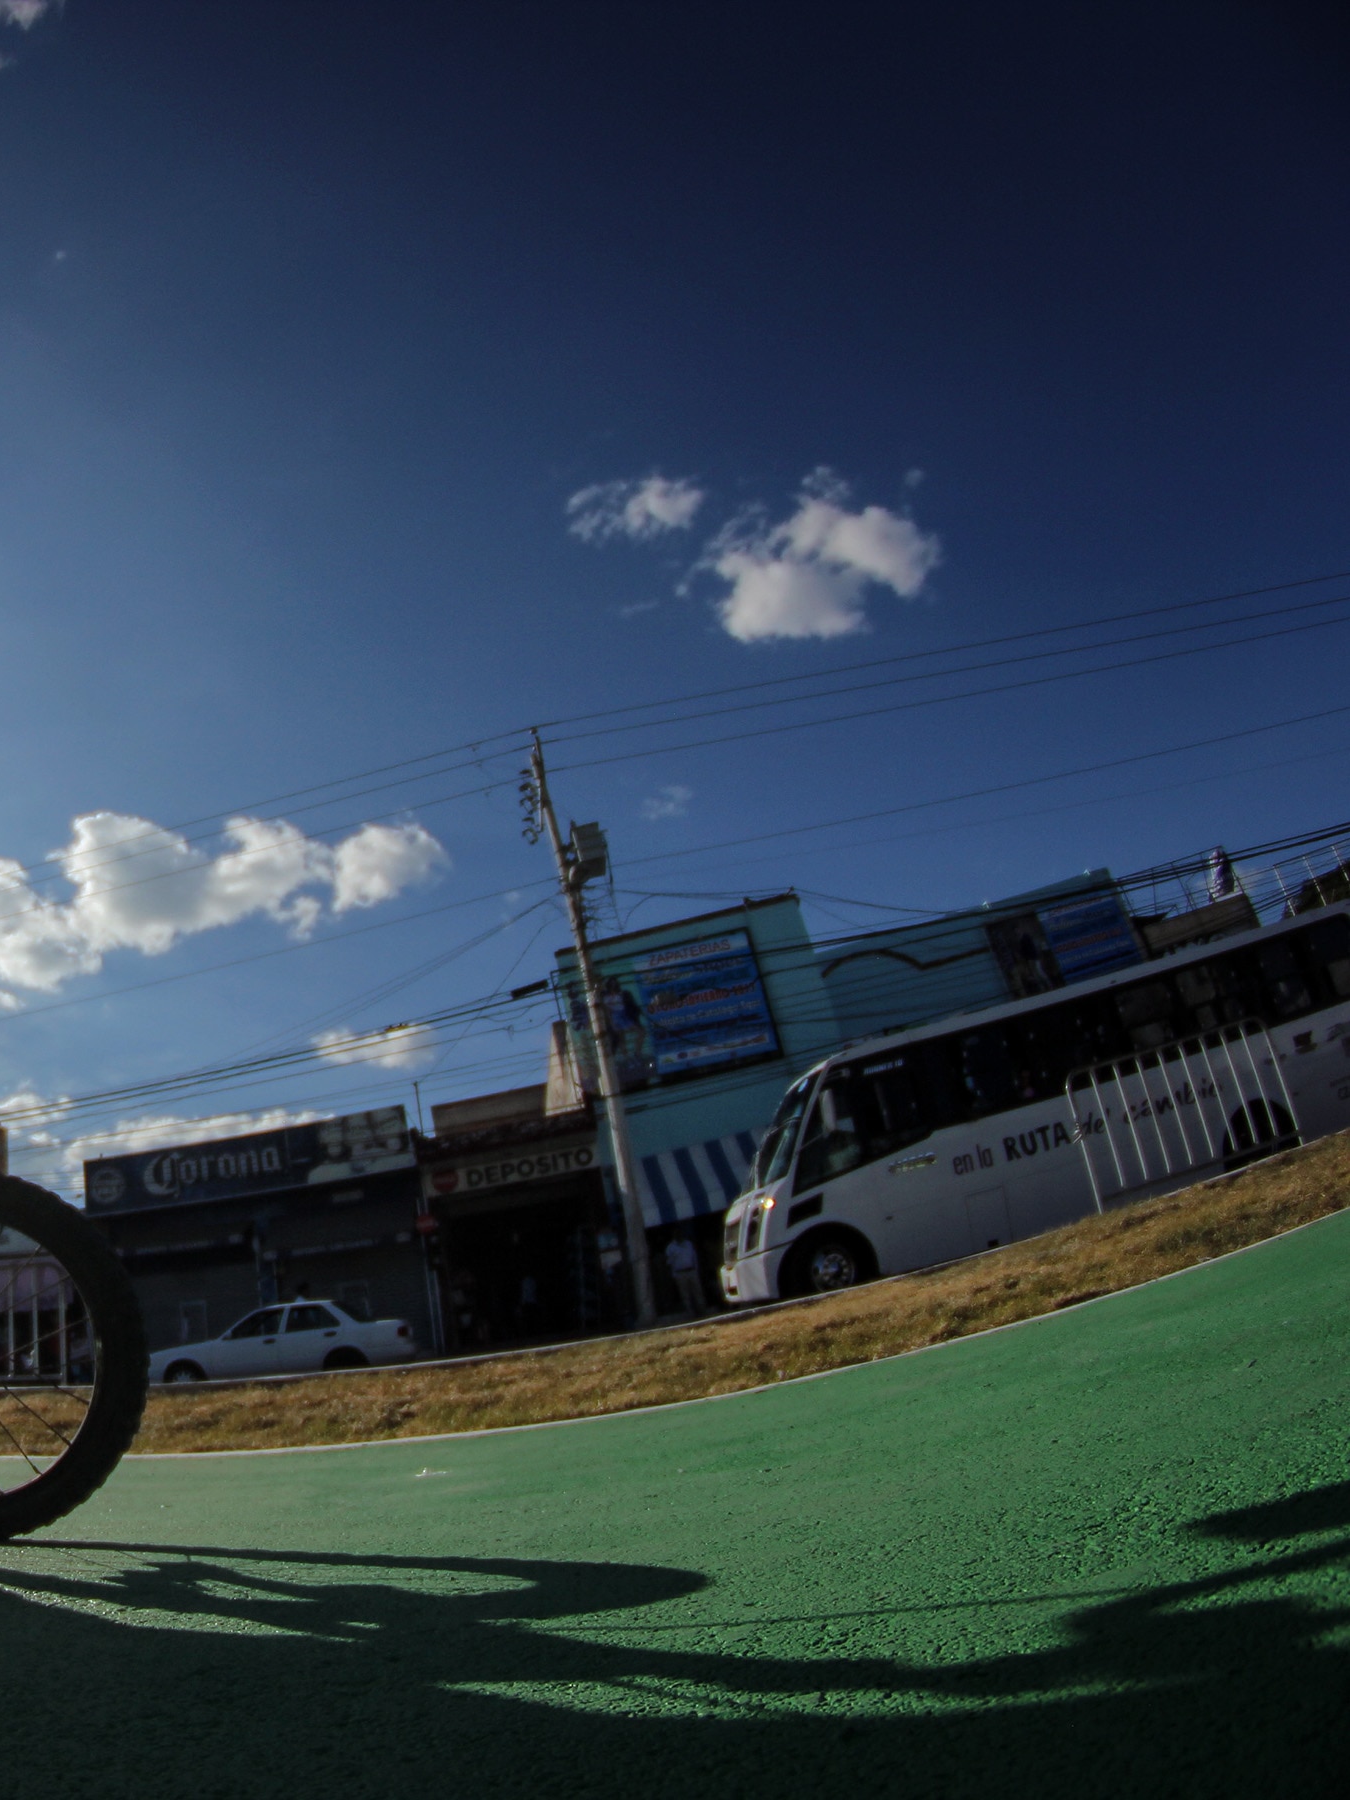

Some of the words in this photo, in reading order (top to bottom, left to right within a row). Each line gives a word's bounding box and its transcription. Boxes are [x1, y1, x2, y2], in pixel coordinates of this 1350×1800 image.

[648, 939, 731, 966] ZAPATERIAS
[466, 1147, 594, 1187] DEPOSITO
[952, 1153, 975, 1175] en
[976, 1144, 994, 1168] la
[1003, 1121, 1072, 1161] RUTA
[143, 1146, 283, 1199] Corona
